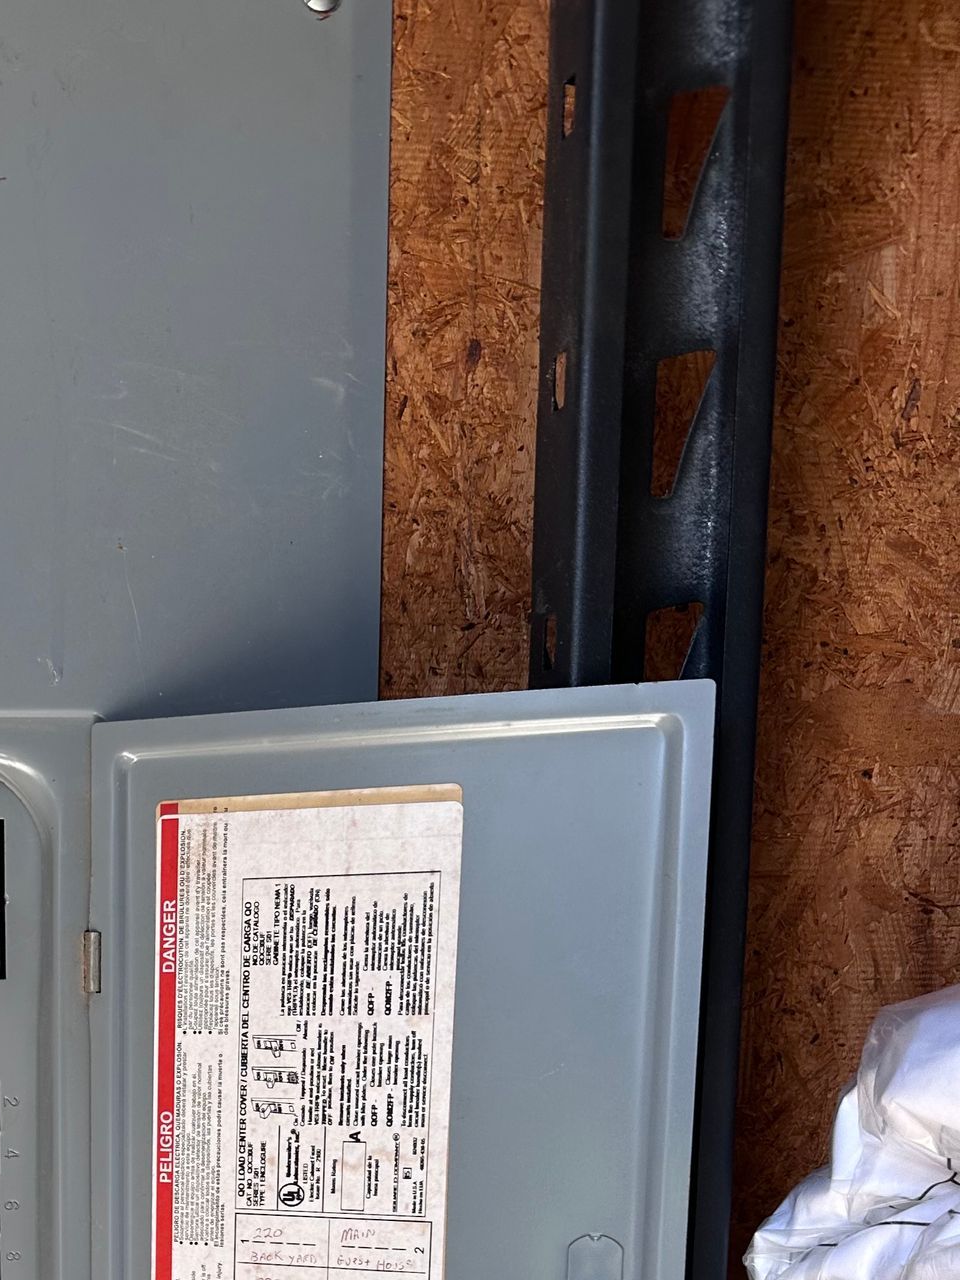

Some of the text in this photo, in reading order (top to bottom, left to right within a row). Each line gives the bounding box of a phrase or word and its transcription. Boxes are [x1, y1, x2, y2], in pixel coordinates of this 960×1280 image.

[245, 902, 252, 915] QO
[162, 900, 176, 973] DANGER
[243, 918, 251, 952] CARGA
[243, 954, 250, 967] DE
[3, 1096, 19, 1107] 2
[4, 1148, 19, 1158] 4
[160, 1111, 172, 1183] PELIGRO
[239, 1183, 245, 1197] QO
[4, 1200, 20, 1210] 6
[253, 1228, 283, 1238] 220
[6, 1251, 21, 1261] 8
[251, 1252, 282, 1261] BACK
